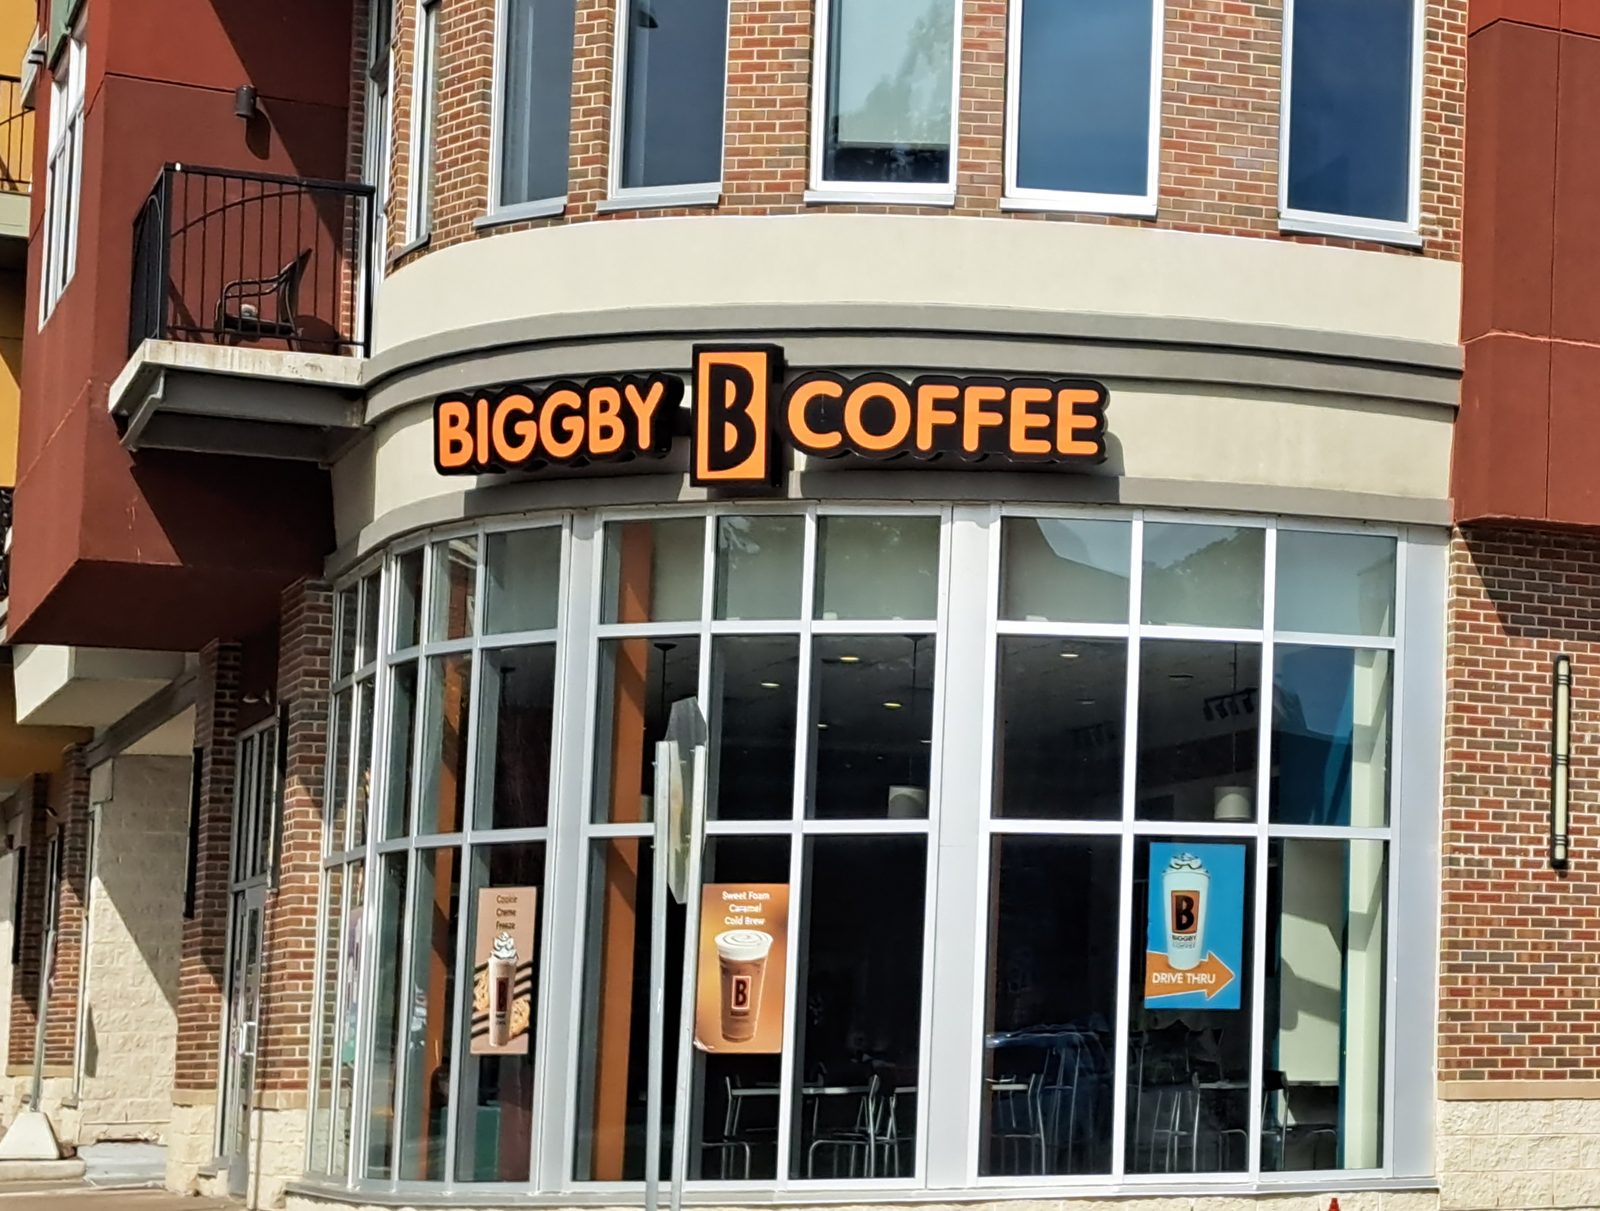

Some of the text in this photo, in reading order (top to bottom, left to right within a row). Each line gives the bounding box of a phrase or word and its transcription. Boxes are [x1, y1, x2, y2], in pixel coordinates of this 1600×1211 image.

[438, 381, 664, 468] BIGGBY
[707, 362, 757, 473] B
[787, 380, 1100, 456] COFFEE
[722, 890, 770, 901] Sweet Foam
[728, 902, 762, 913] Caramel
[724, 916, 766, 926] Cold Brew
[1175, 895, 1194, 931] B
[1152, 972, 1217, 985] DRIVE THRU
[735, 979, 748, 1006] B
